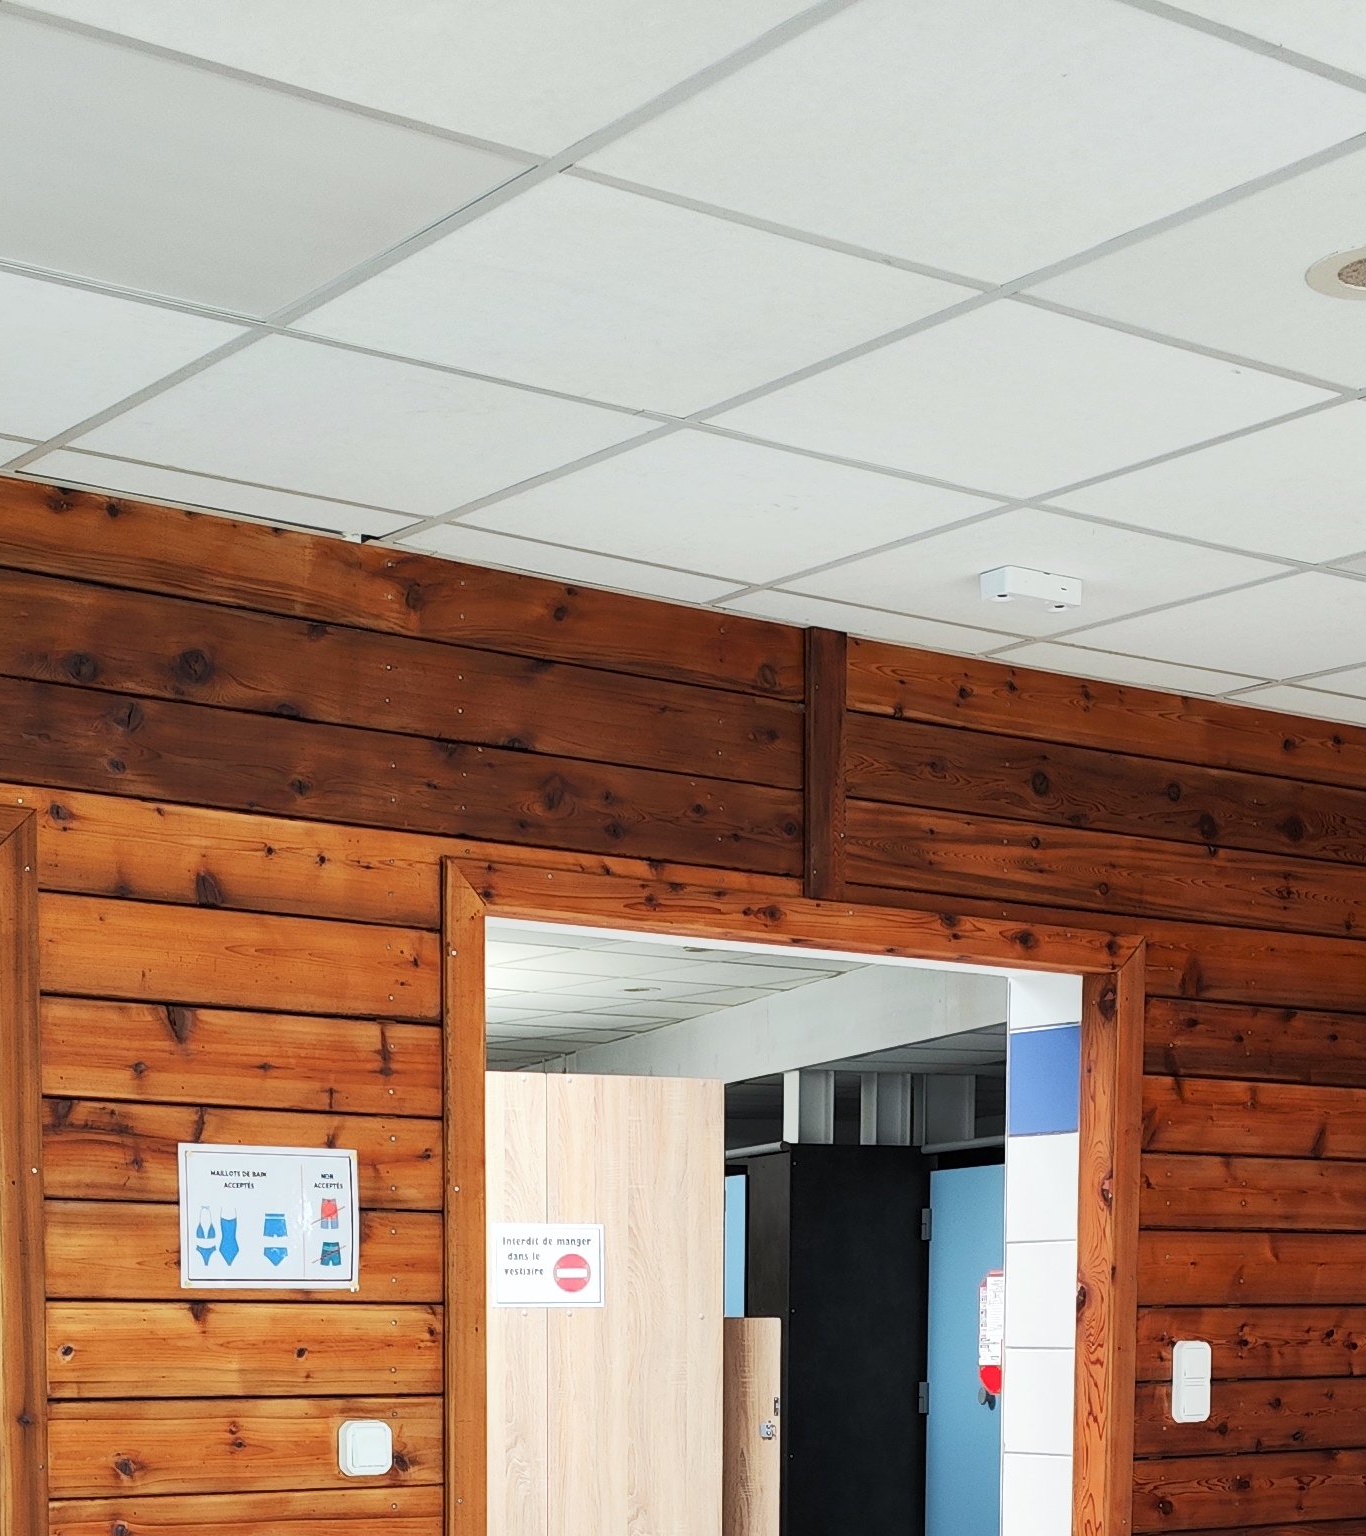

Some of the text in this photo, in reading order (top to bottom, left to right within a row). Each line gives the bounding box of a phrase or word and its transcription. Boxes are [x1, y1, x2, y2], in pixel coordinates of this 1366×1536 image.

[210, 1170, 241, 1178] MAILLOTS
[223, 1181, 255, 1189] ACCEPTÉS
[313, 1181, 343, 1189] ACCEPTÉS
[502, 1237, 591, 1247] Interdit de manger
[507, 1252, 540, 1260] dans le
[504, 1268, 544, 1276] vestiaire
